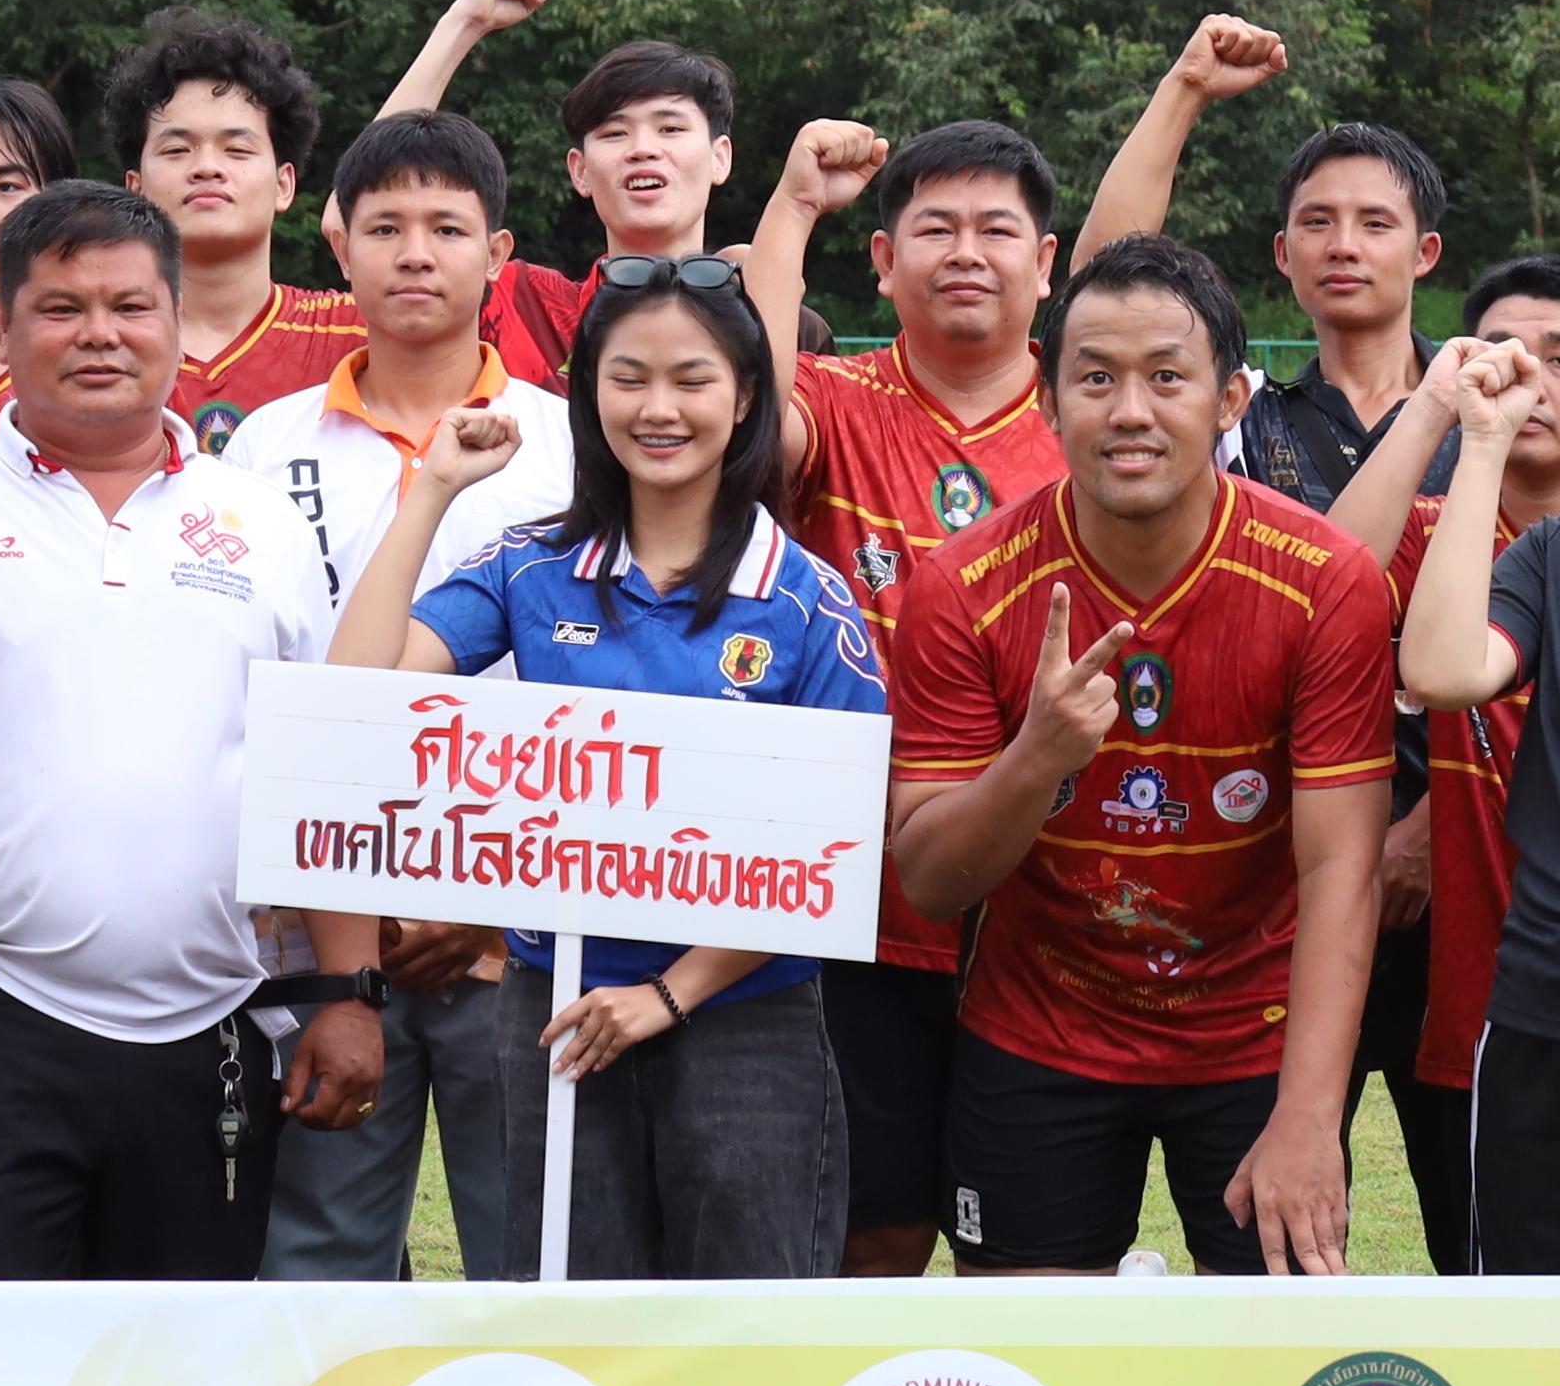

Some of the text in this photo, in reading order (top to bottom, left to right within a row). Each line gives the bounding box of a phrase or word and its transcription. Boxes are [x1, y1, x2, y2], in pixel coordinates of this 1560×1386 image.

[958, 519, 1041, 588] KPRUMS
[1241, 517, 1333, 568] COMTMS
[408, 693, 663, 812] ศิษย์เก่า
[295, 796, 865, 919] เทคโนโลยีคอมพิวเตอร์
